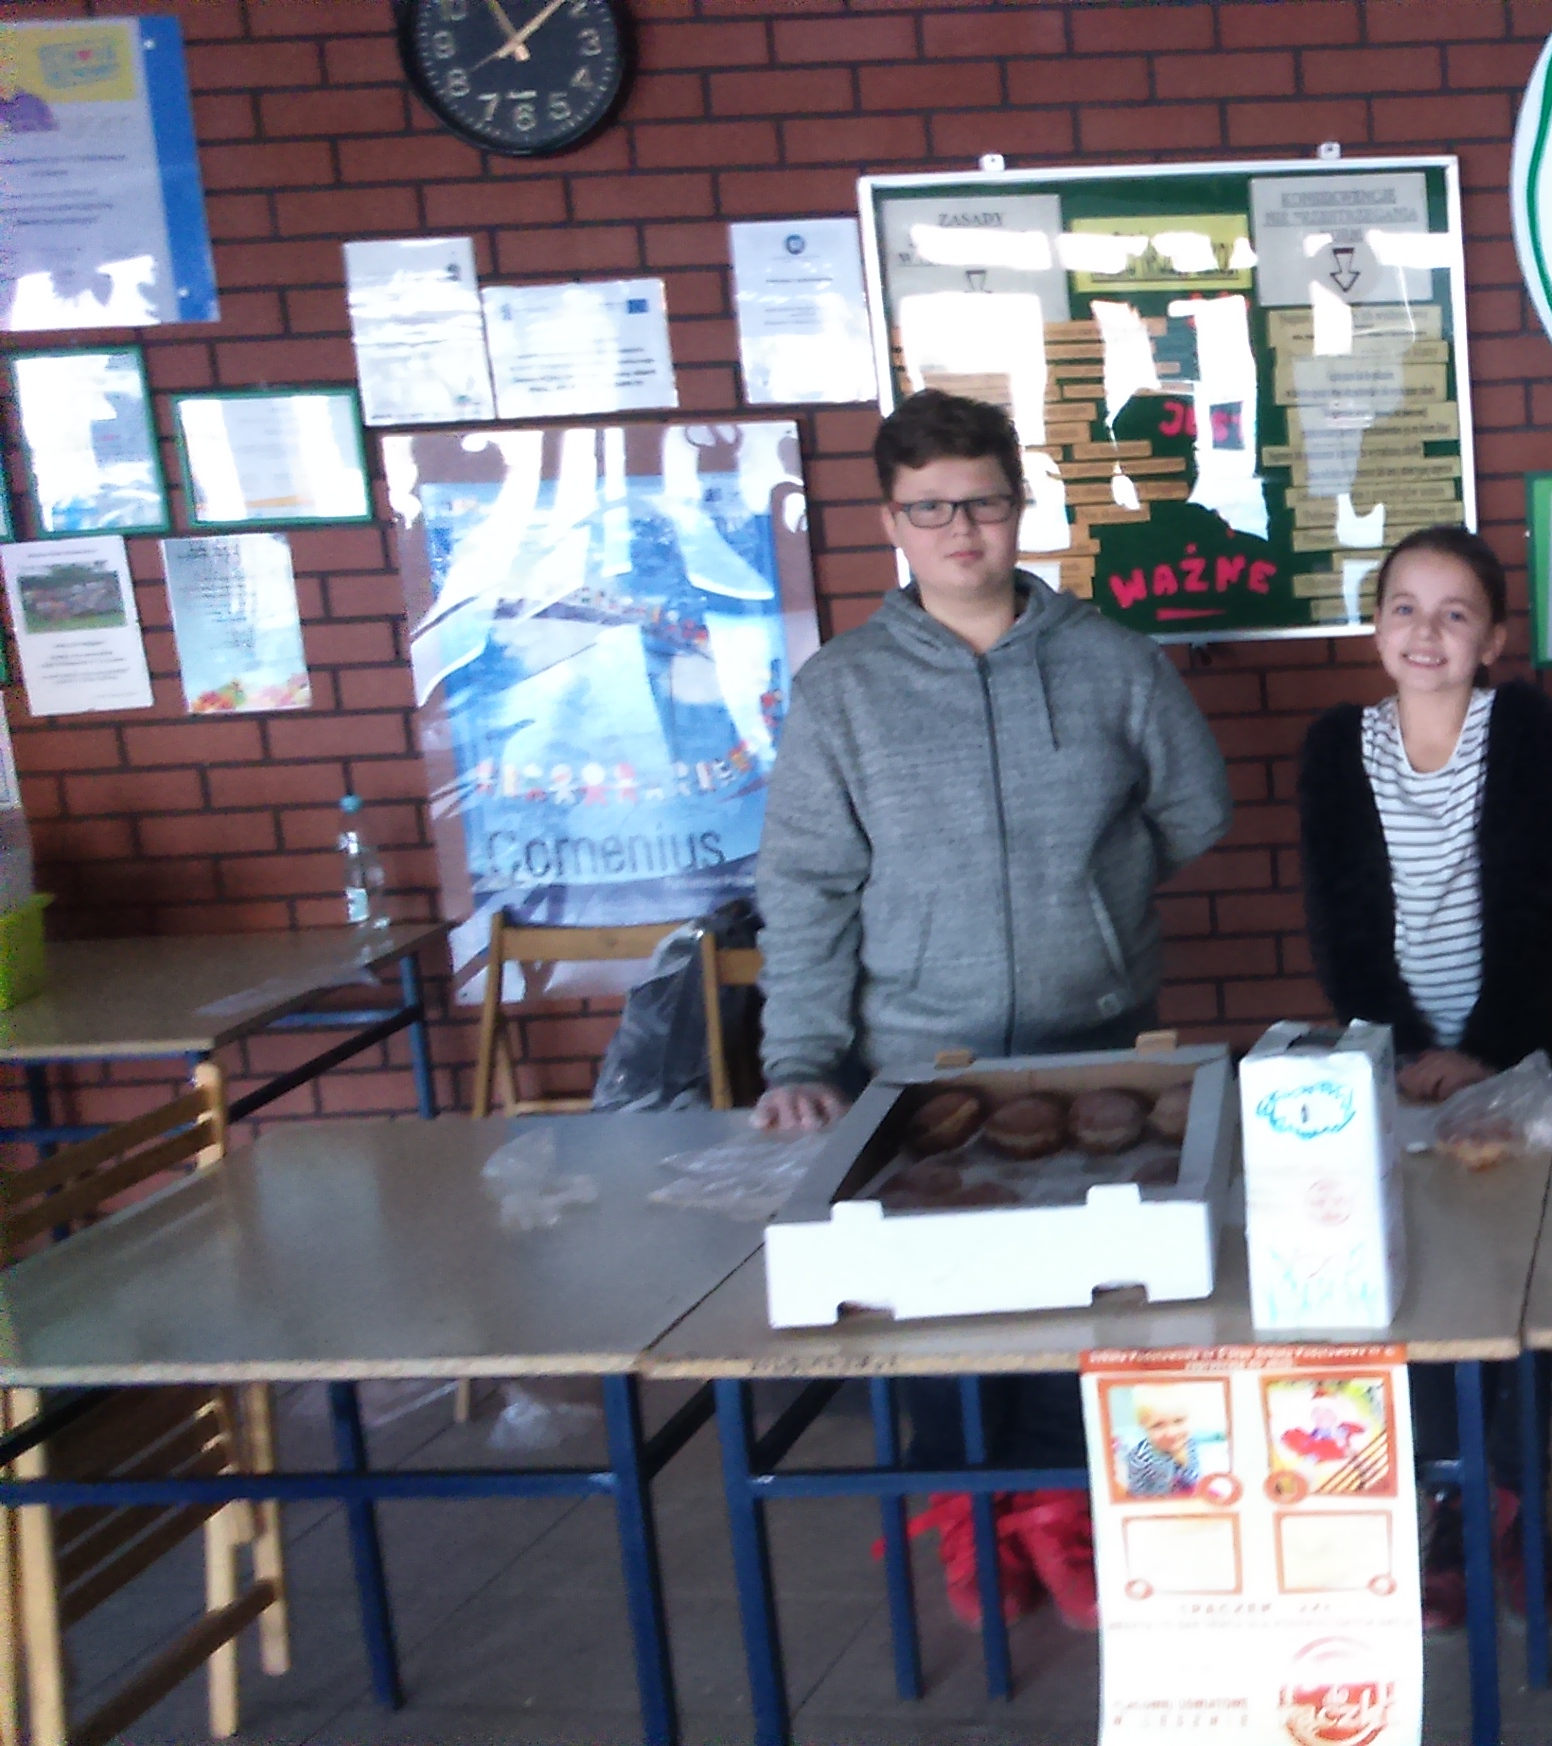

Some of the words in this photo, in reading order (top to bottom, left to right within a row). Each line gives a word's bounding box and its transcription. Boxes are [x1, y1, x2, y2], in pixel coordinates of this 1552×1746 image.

[433, 29, 456, 60] 9
[578, 27, 602, 56] 3
[447, 68, 470, 98] 8
[571, 67, 593, 88] 4
[476, 92, 500, 122] 7
[513, 102, 537, 132] 6
[548, 91, 572, 121] 5
[937, 212, 1005, 228] ZASADY
[1108, 542, 1277, 609] WAŻNE
[485, 822, 726, 884] Comenius
